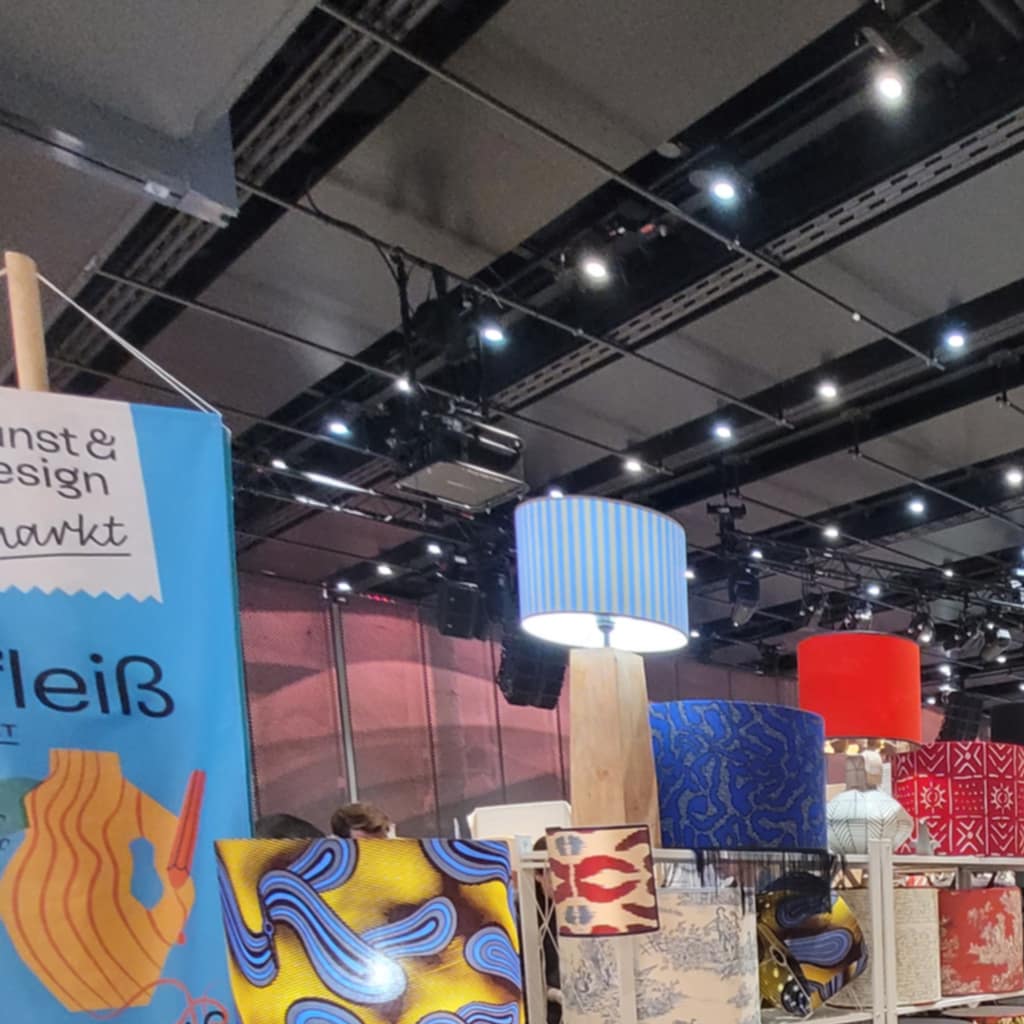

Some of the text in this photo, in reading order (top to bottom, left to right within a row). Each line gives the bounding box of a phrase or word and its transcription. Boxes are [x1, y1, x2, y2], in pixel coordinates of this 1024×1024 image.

[0, 427, 117, 461] nst &
[0, 648, 175, 718] leiß
